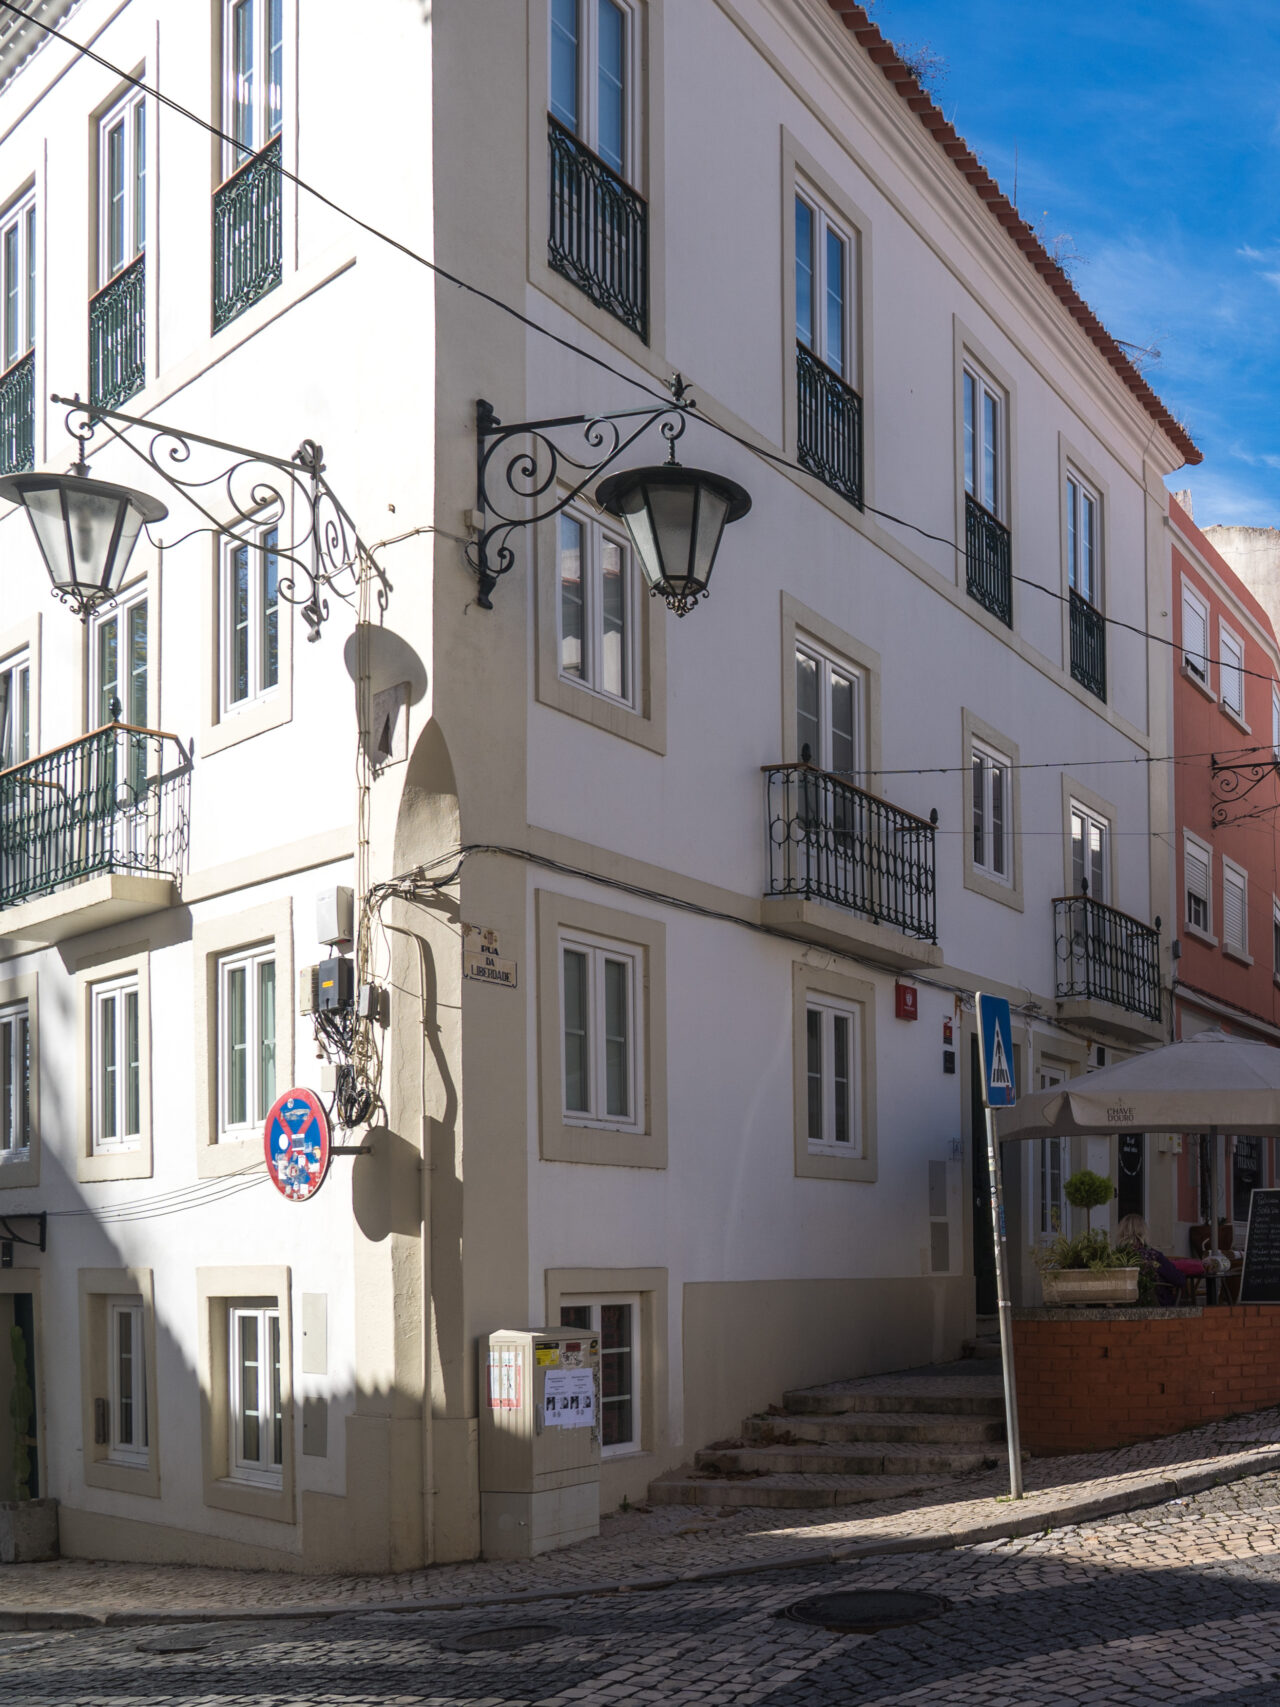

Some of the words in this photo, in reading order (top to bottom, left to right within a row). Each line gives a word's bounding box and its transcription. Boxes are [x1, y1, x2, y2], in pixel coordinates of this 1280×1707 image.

[481, 945, 499, 956] RUA
[486, 957, 495, 966] DA
[471, 964, 511, 982] LIBERDADE
